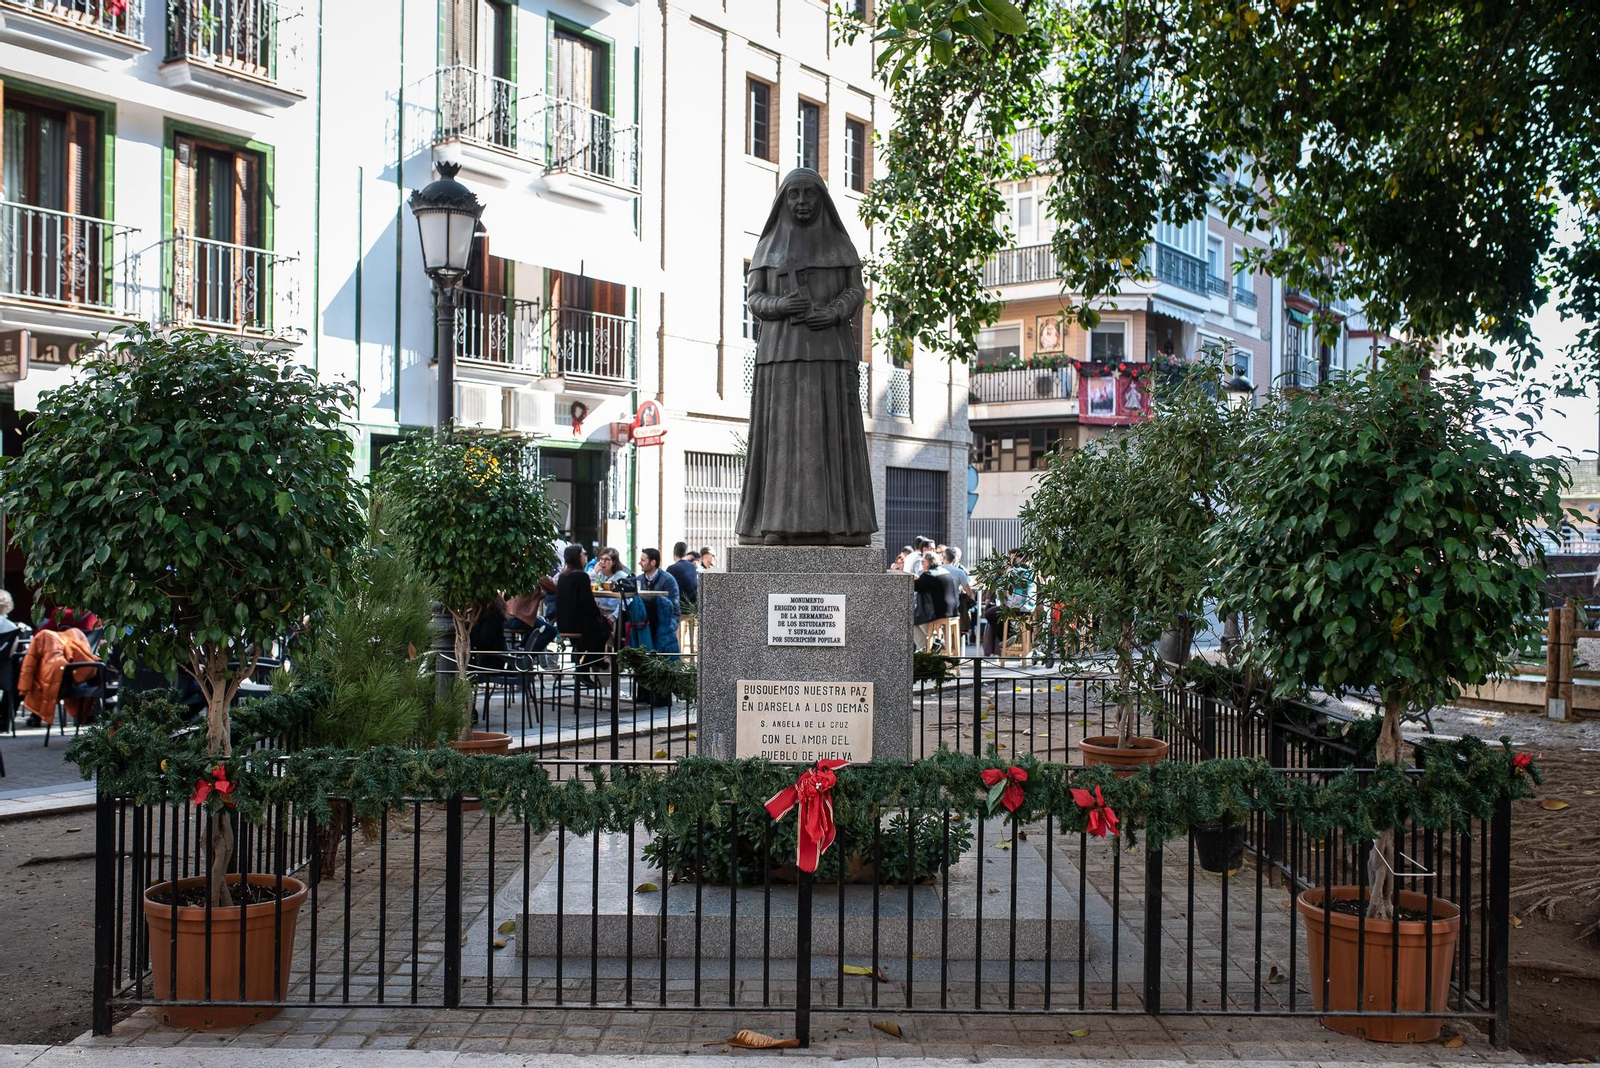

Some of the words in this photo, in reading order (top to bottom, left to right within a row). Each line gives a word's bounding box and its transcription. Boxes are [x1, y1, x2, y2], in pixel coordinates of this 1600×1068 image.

[30, 338, 60, 362] La
[744, 685, 800, 695] BUSQUEMOS
[804, 686, 846, 696] NUESTRA
[850, 686, 867, 696] PAZ
[742, 702, 754, 711] EN
[758, 702, 800, 712] DARSELA
[805, 703, 810, 712] A
[814, 703, 833, 712] LOS
[762, 734, 779, 744] CON
[786, 735, 796, 744] EL
[802, 735, 827, 744] AMOR
[832, 735, 849, 745] DEL
[761, 750, 797, 760] PUEBLO
[802, 751, 813, 760] DE
[818, 752, 852, 761] HUELVA
